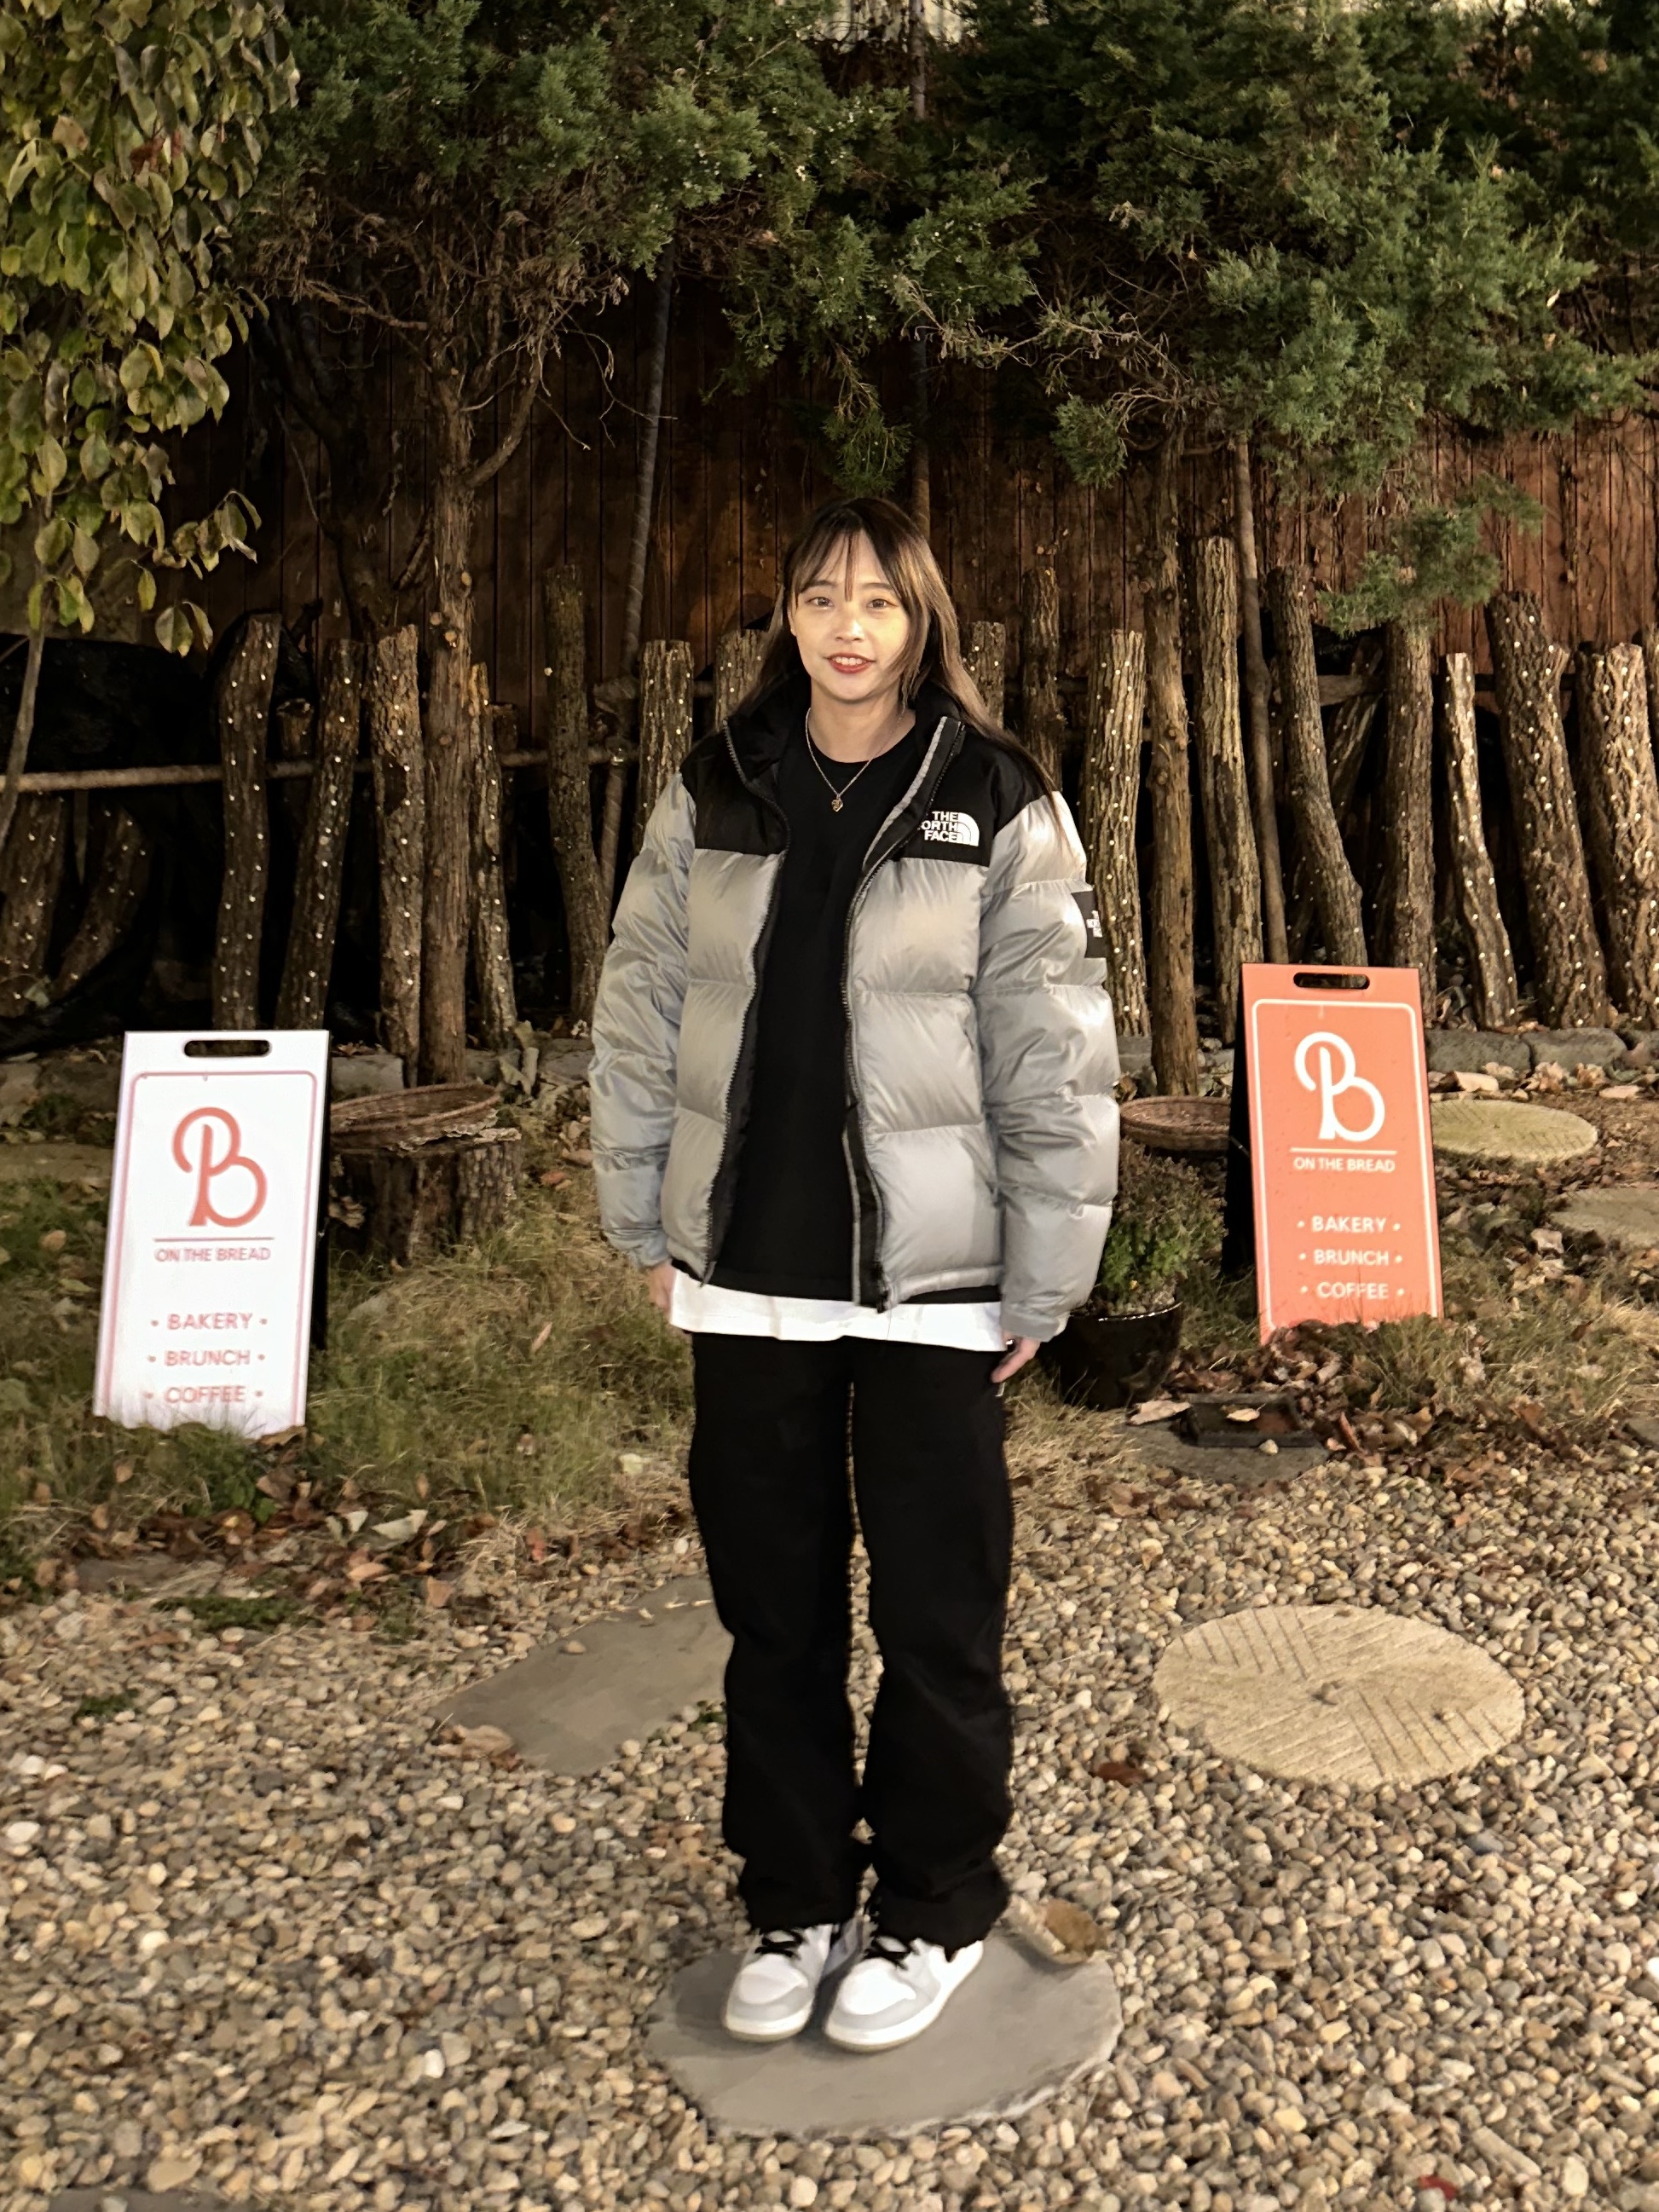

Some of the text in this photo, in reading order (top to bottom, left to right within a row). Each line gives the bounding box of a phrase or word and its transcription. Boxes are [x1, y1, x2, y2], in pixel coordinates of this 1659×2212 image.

[932, 811, 958, 822] THE
[921, 820, 957, 832] ORTH
[924, 830, 957, 843] FACE
[1293, 1157, 1396, 1173] ON THE BREAD
[1311, 1216, 1387, 1233] BAKERY
[154, 1246, 271, 1262] ON THE BREAD
[1314, 1249, 1389, 1266] BRUNCH
[1317, 1281, 1389, 1300] COFFEE
[166, 1312, 253, 1330] BAKERY
[164, 1349, 251, 1366] BRUNCH
[164, 1385, 246, 1404] COFFEE
